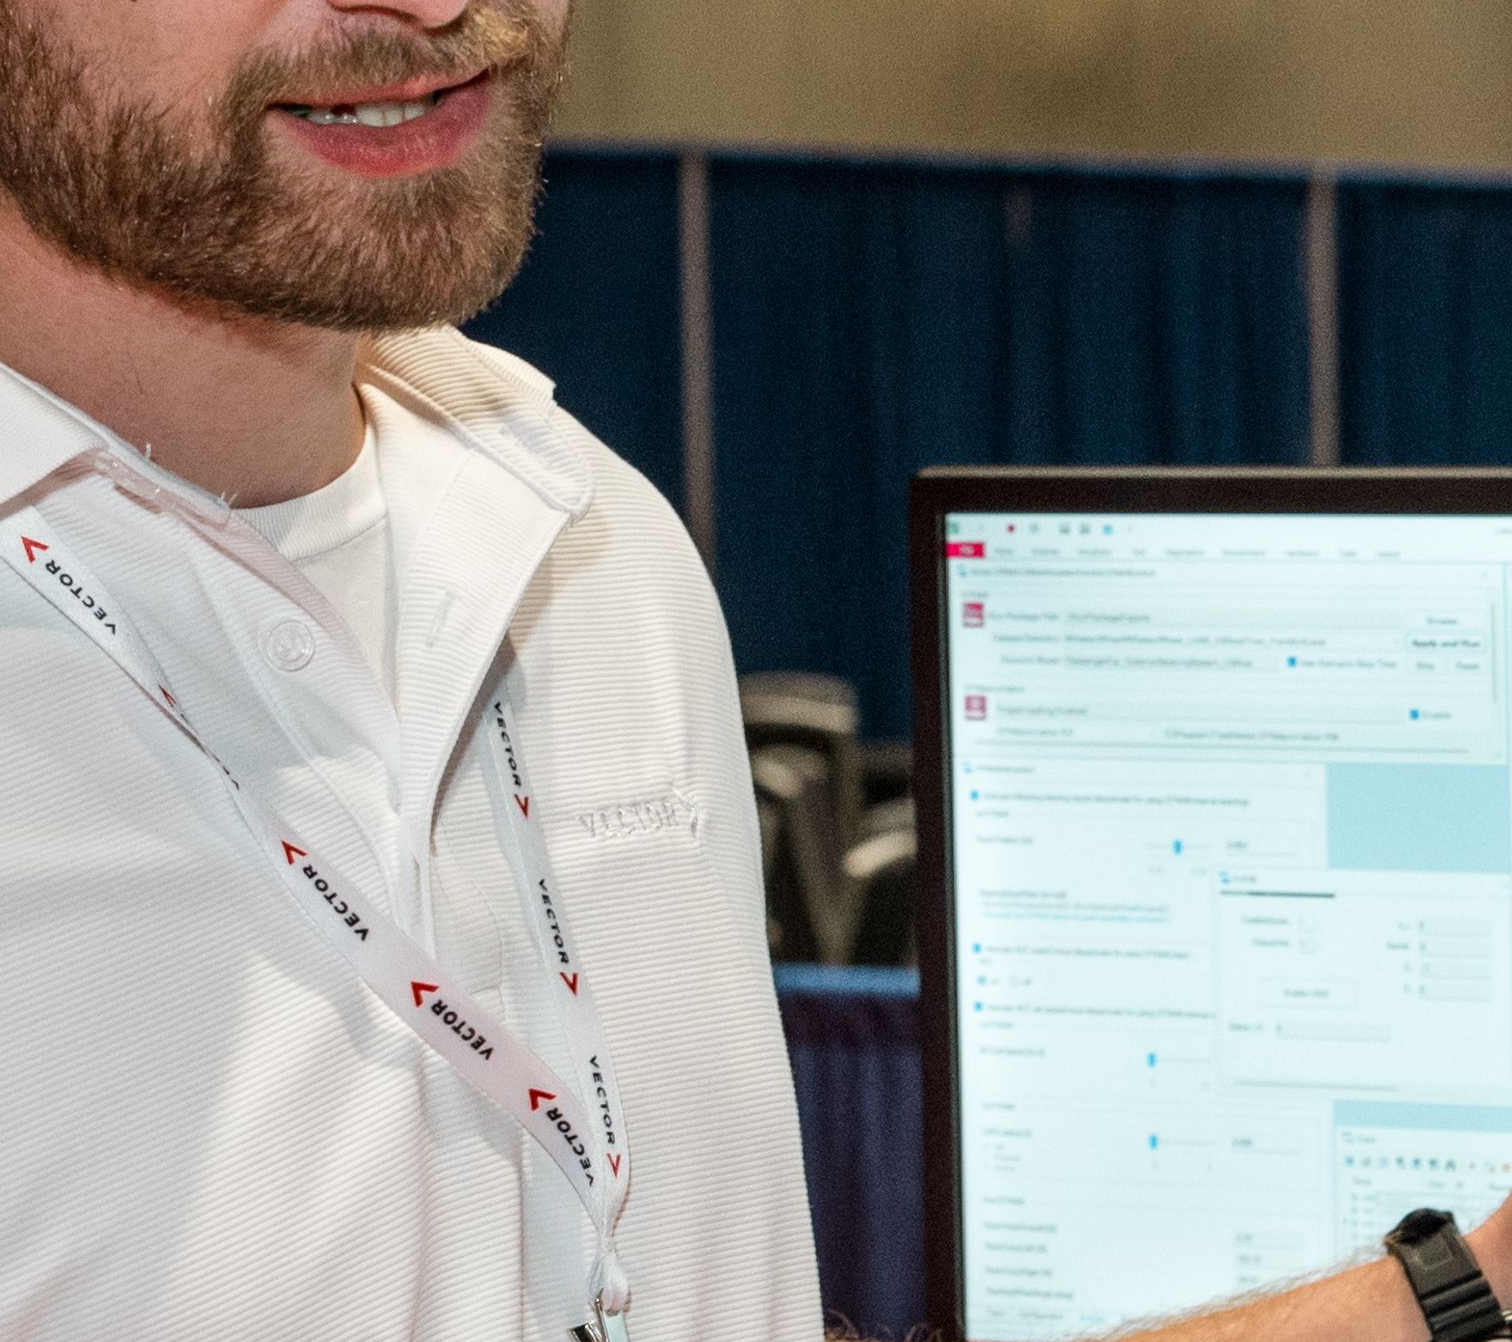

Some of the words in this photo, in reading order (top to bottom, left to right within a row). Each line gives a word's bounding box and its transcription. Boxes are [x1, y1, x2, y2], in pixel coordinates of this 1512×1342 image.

[44, 558, 117, 637] VECTOR
[493, 701, 523, 790] VECTOR
[303, 862, 370, 943] VECTOR
[537, 878, 571, 966] VECTOR
[430, 997, 493, 1062] VECTOR
[588, 1054, 618, 1146] VECTOR
[546, 1105, 596, 1187] VECTOR
